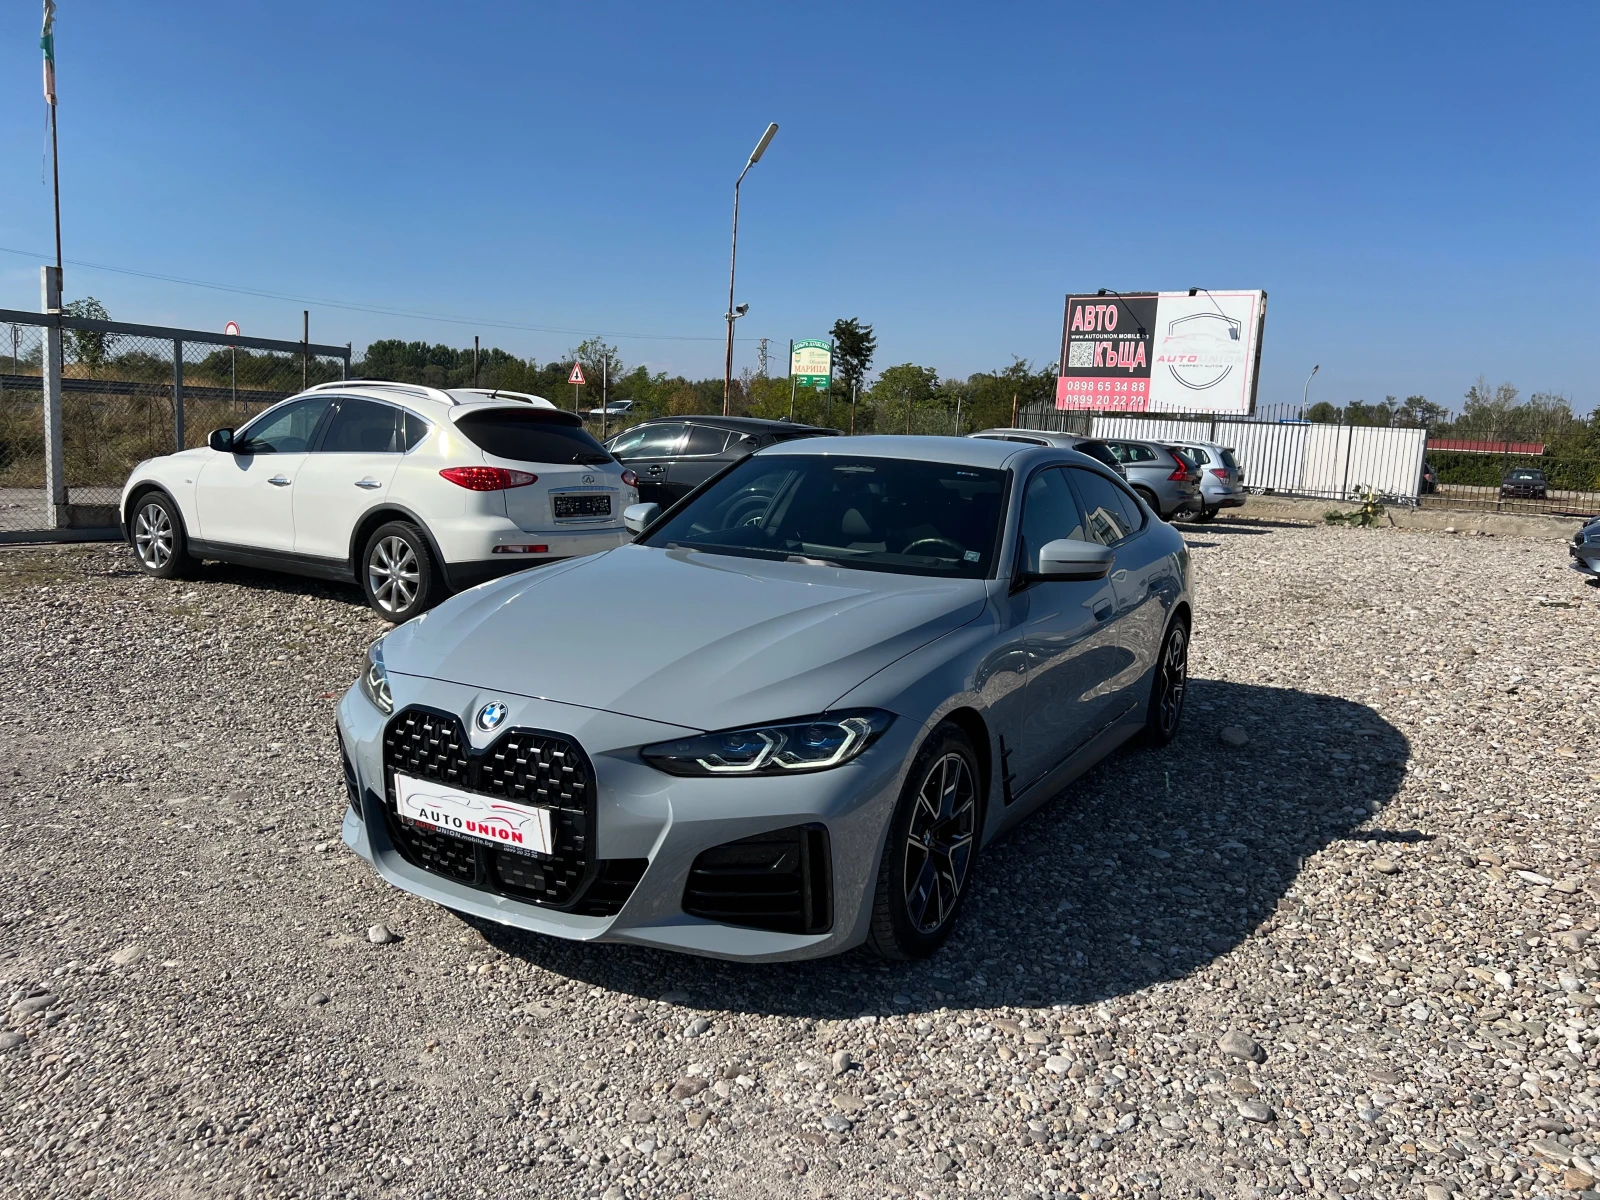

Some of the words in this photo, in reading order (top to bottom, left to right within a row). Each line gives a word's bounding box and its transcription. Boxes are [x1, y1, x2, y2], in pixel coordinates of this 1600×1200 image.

[1071, 304, 1118, 332] АВТО
[794, 365, 827, 373] МАРИЦА
[1093, 341, 1146, 373] КЪЩА
[1066, 394, 1093, 404] 0899
[1096, 395, 1110, 405] 20
[1113, 395, 1127, 405] 22
[1130, 395, 1145, 406] 20
[1067, 381, 1094, 391] 0898
[1097, 381, 1111, 391] 65
[1114, 382, 1128, 392] 34
[1131, 382, 1145, 392] 88
[415, 820, 494, 849] AUTOUNION.mobile.bg
[419, 807, 463, 829] AUTO
[466, 820, 523, 844] UNION
